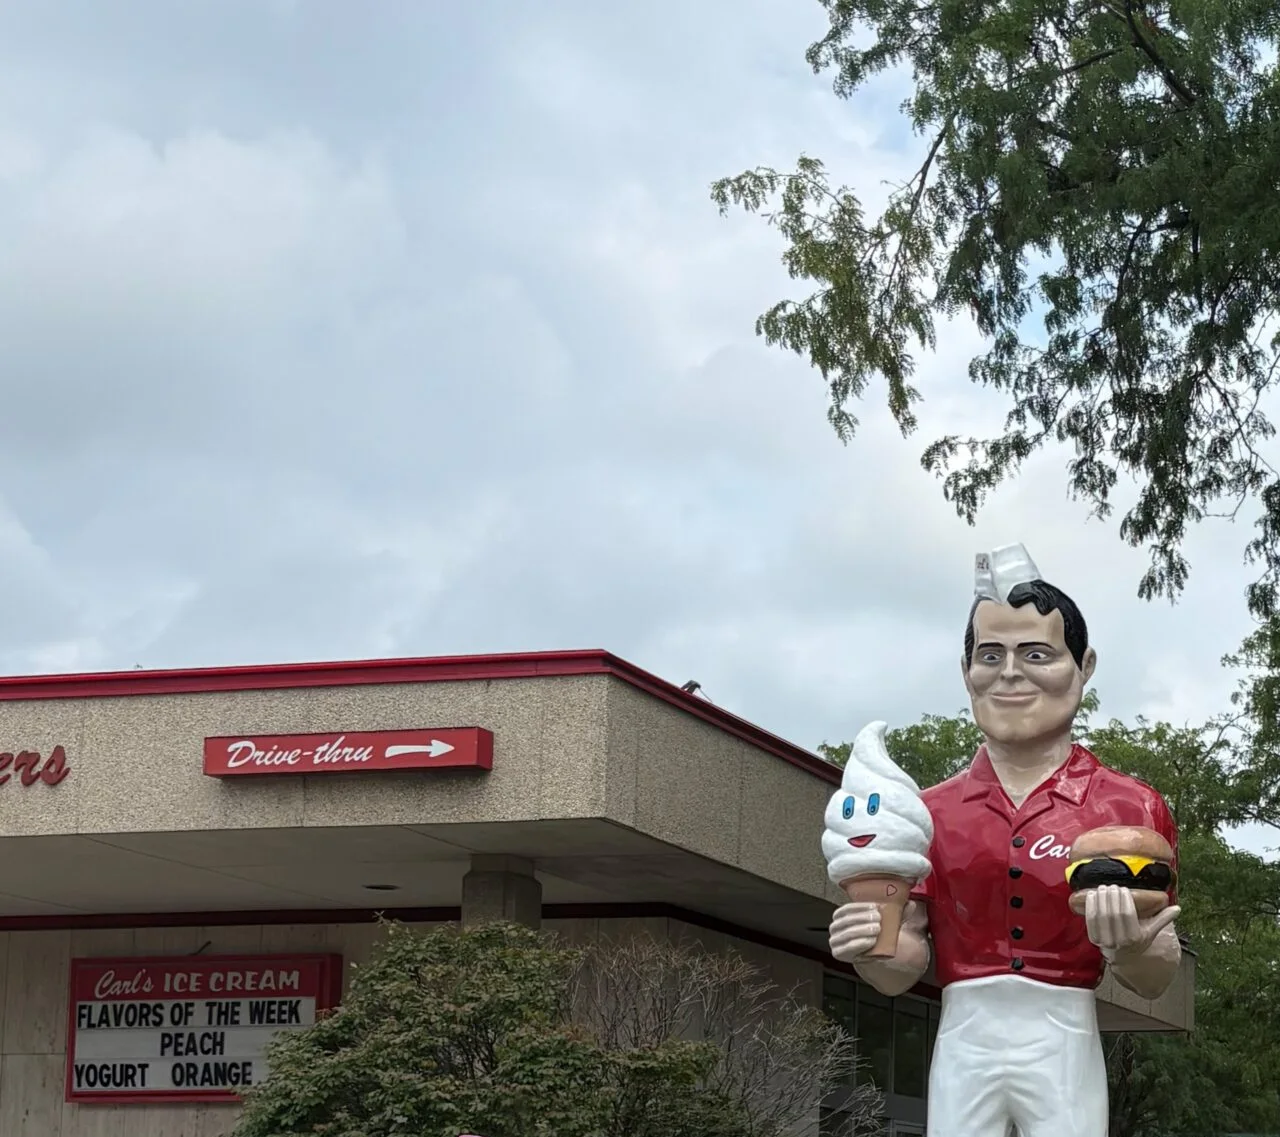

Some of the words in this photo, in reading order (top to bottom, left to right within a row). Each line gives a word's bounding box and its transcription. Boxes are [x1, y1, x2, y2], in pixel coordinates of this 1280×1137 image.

[227, 735, 373, 768] Drive-thru
[94, 968, 154, 999] Carl's
[164, 972, 201, 992] ICE
[209, 970, 299, 993] CREAM
[77, 1003, 164, 1029] FLAVORS
[170, 1002, 195, 1026] OF
[205, 1001, 241, 1025] THE
[249, 1000, 301, 1024] WEEK
[160, 1031, 225, 1056] PEACH
[74, 1063, 149, 1088] YOGURT
[171, 1061, 252, 1087] ORANGE
